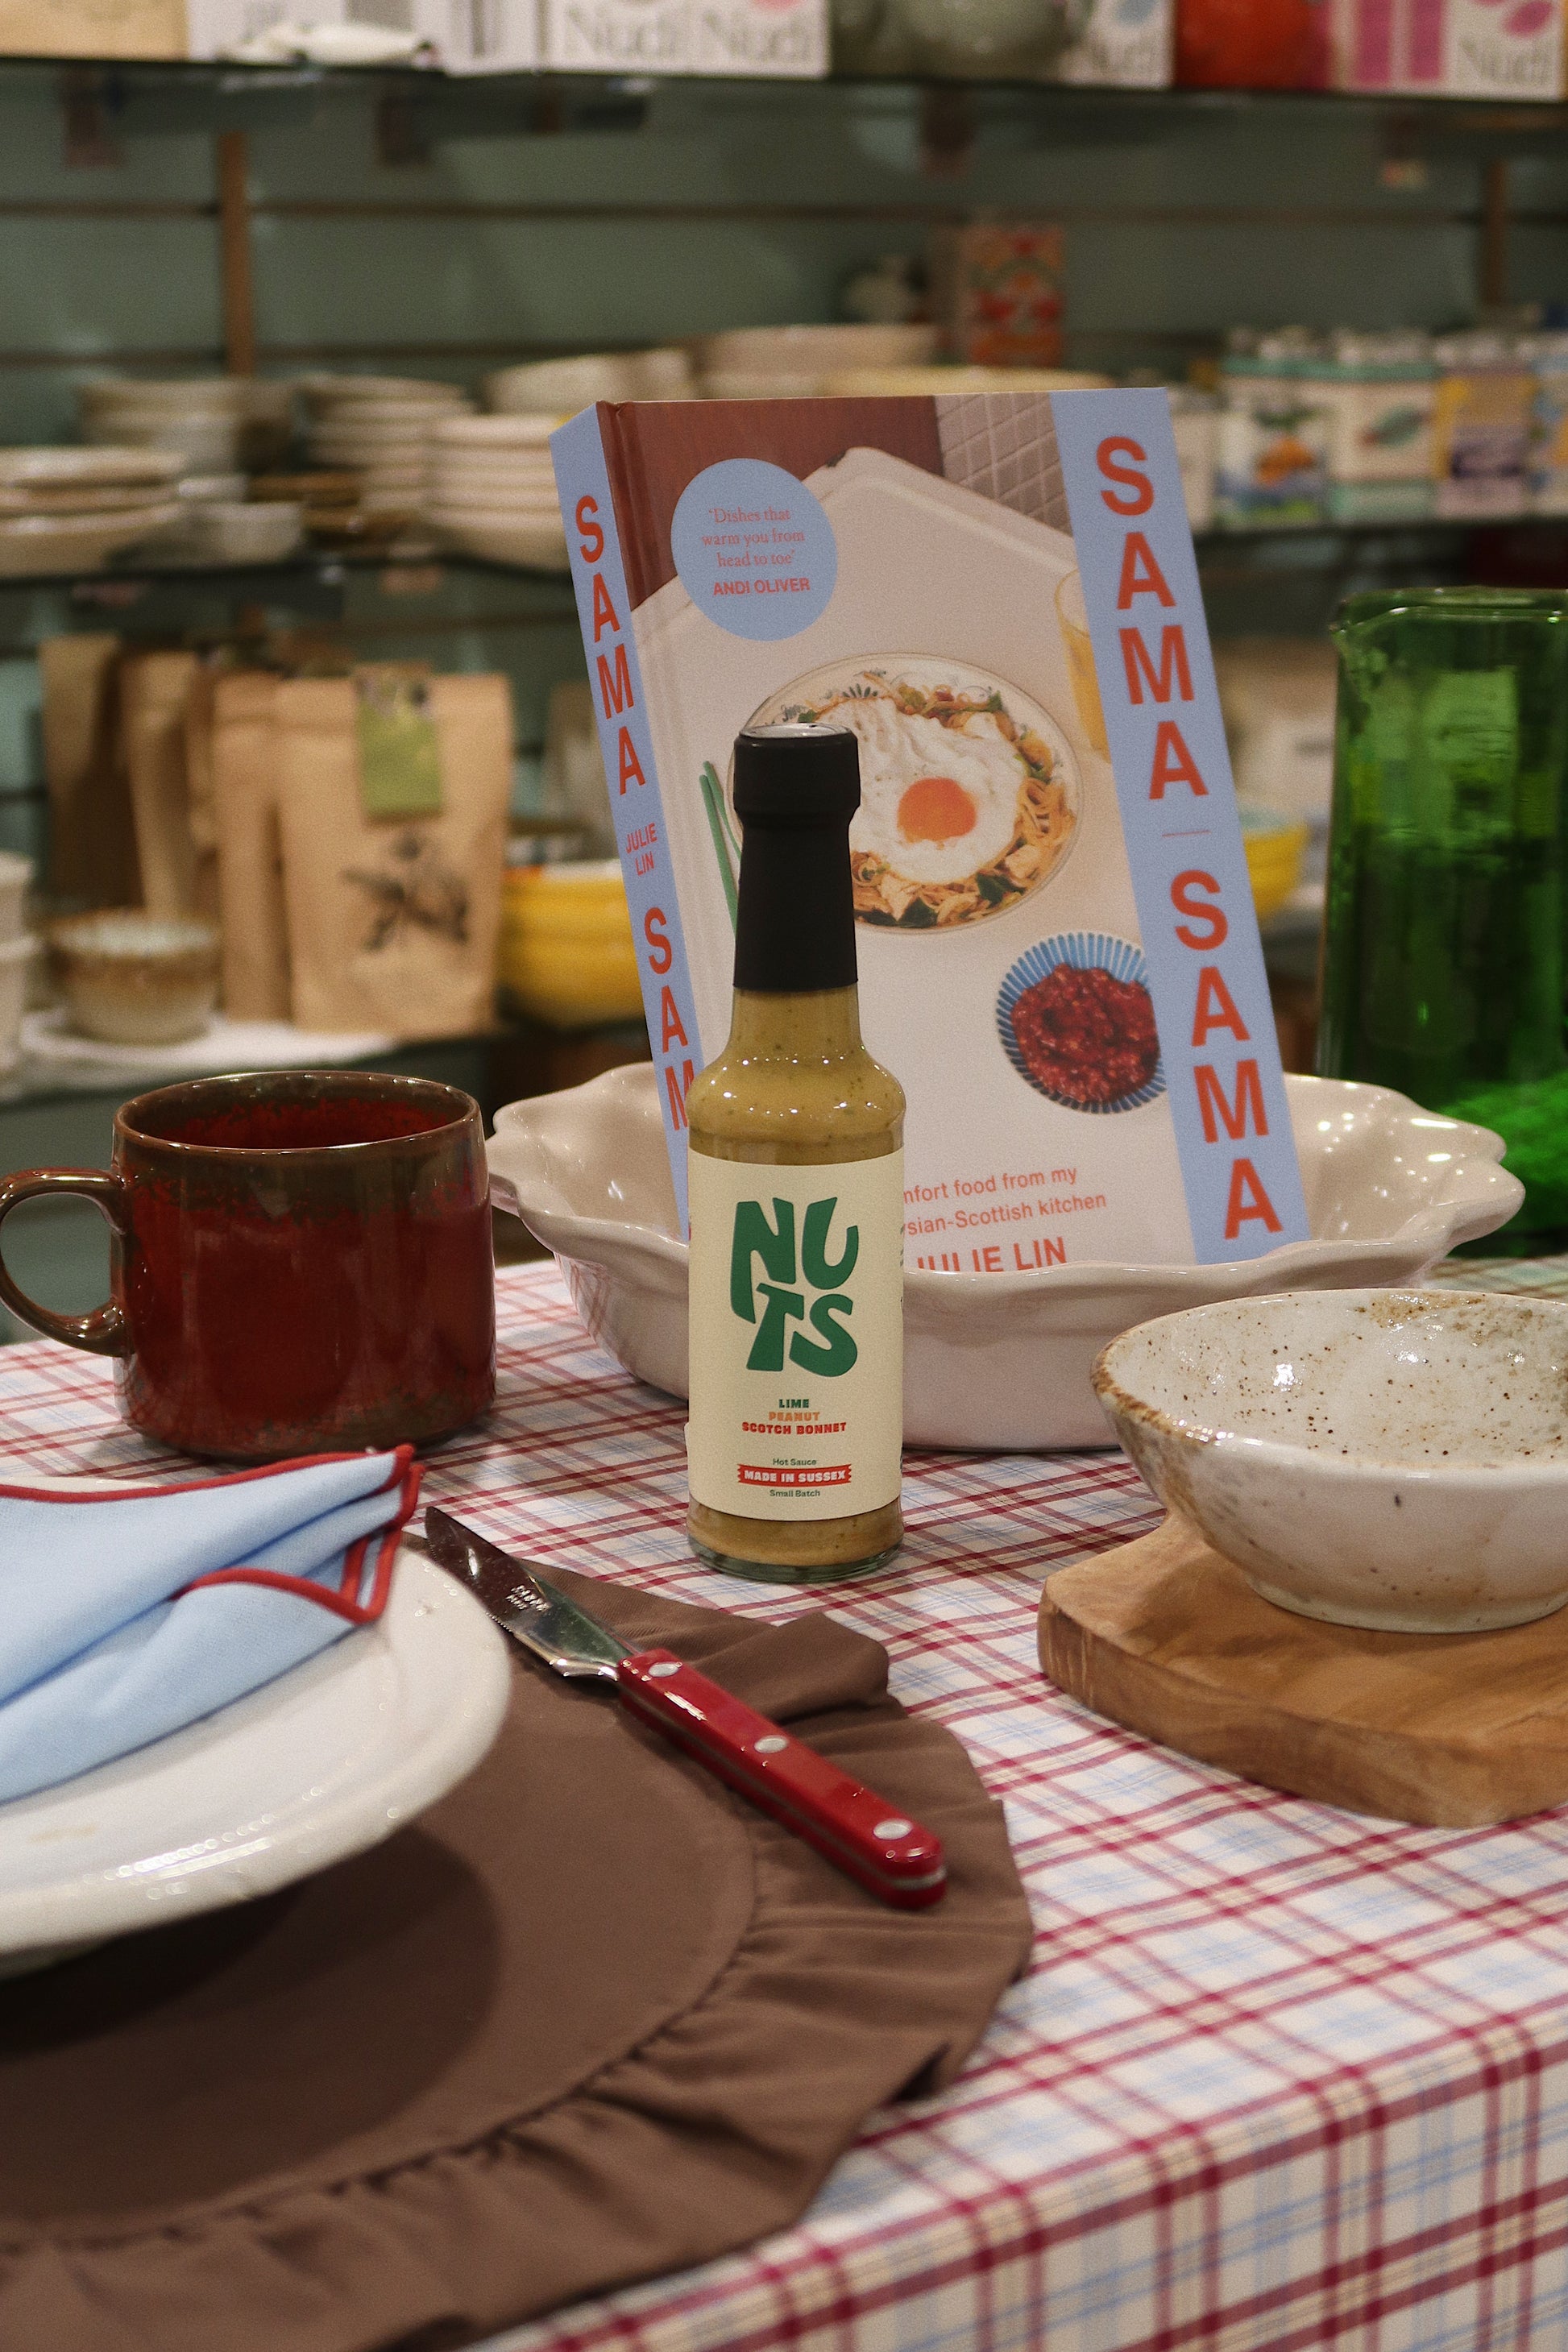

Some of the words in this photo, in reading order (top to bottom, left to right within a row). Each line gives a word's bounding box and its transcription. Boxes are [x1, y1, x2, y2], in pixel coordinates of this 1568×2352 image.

[708, 506, 761, 523] ‘Dishes
[763, 506, 791, 521] that
[701, 535, 740, 546] warm
[744, 533, 769, 548] you
[772, 528, 804, 543] from
[716, 551, 751, 568] head
[754, 553, 767, 566] to
[771, 549, 795, 566] toe’
[713, 580, 750, 595] ANDI
[753, 577, 811, 594] OLIVER
[575, 496, 645, 795] SAMA
[626, 823, 657, 854] JULIE
[1096, 436, 1209, 800] SAMA
[1171, 870, 1284, 1239] SAMA
[636, 851, 654, 876] LIN
[645, 907, 695, 1130] SAM
[954, 1176, 997, 1197] food
[1002, 1172, 1045, 1190] from
[1051, 1168, 1077, 1185] my
[903, 1201, 1033, 1237] sian-Scottish
[1038, 1194, 1106, 1217] kitchen
[1014, 1236, 1067, 1271] LIN
[778, 1399, 809, 1408] LIME
[768, 1412, 820, 1421] PEANUT
[742, 1422, 791, 1434] SCOTCH
[796, 1422, 847, 1435] BONNET
[744, 1470, 777, 1482] MADE
[781, 1473, 794, 1483] IN
[798, 1470, 846, 1483] SUSSEX
